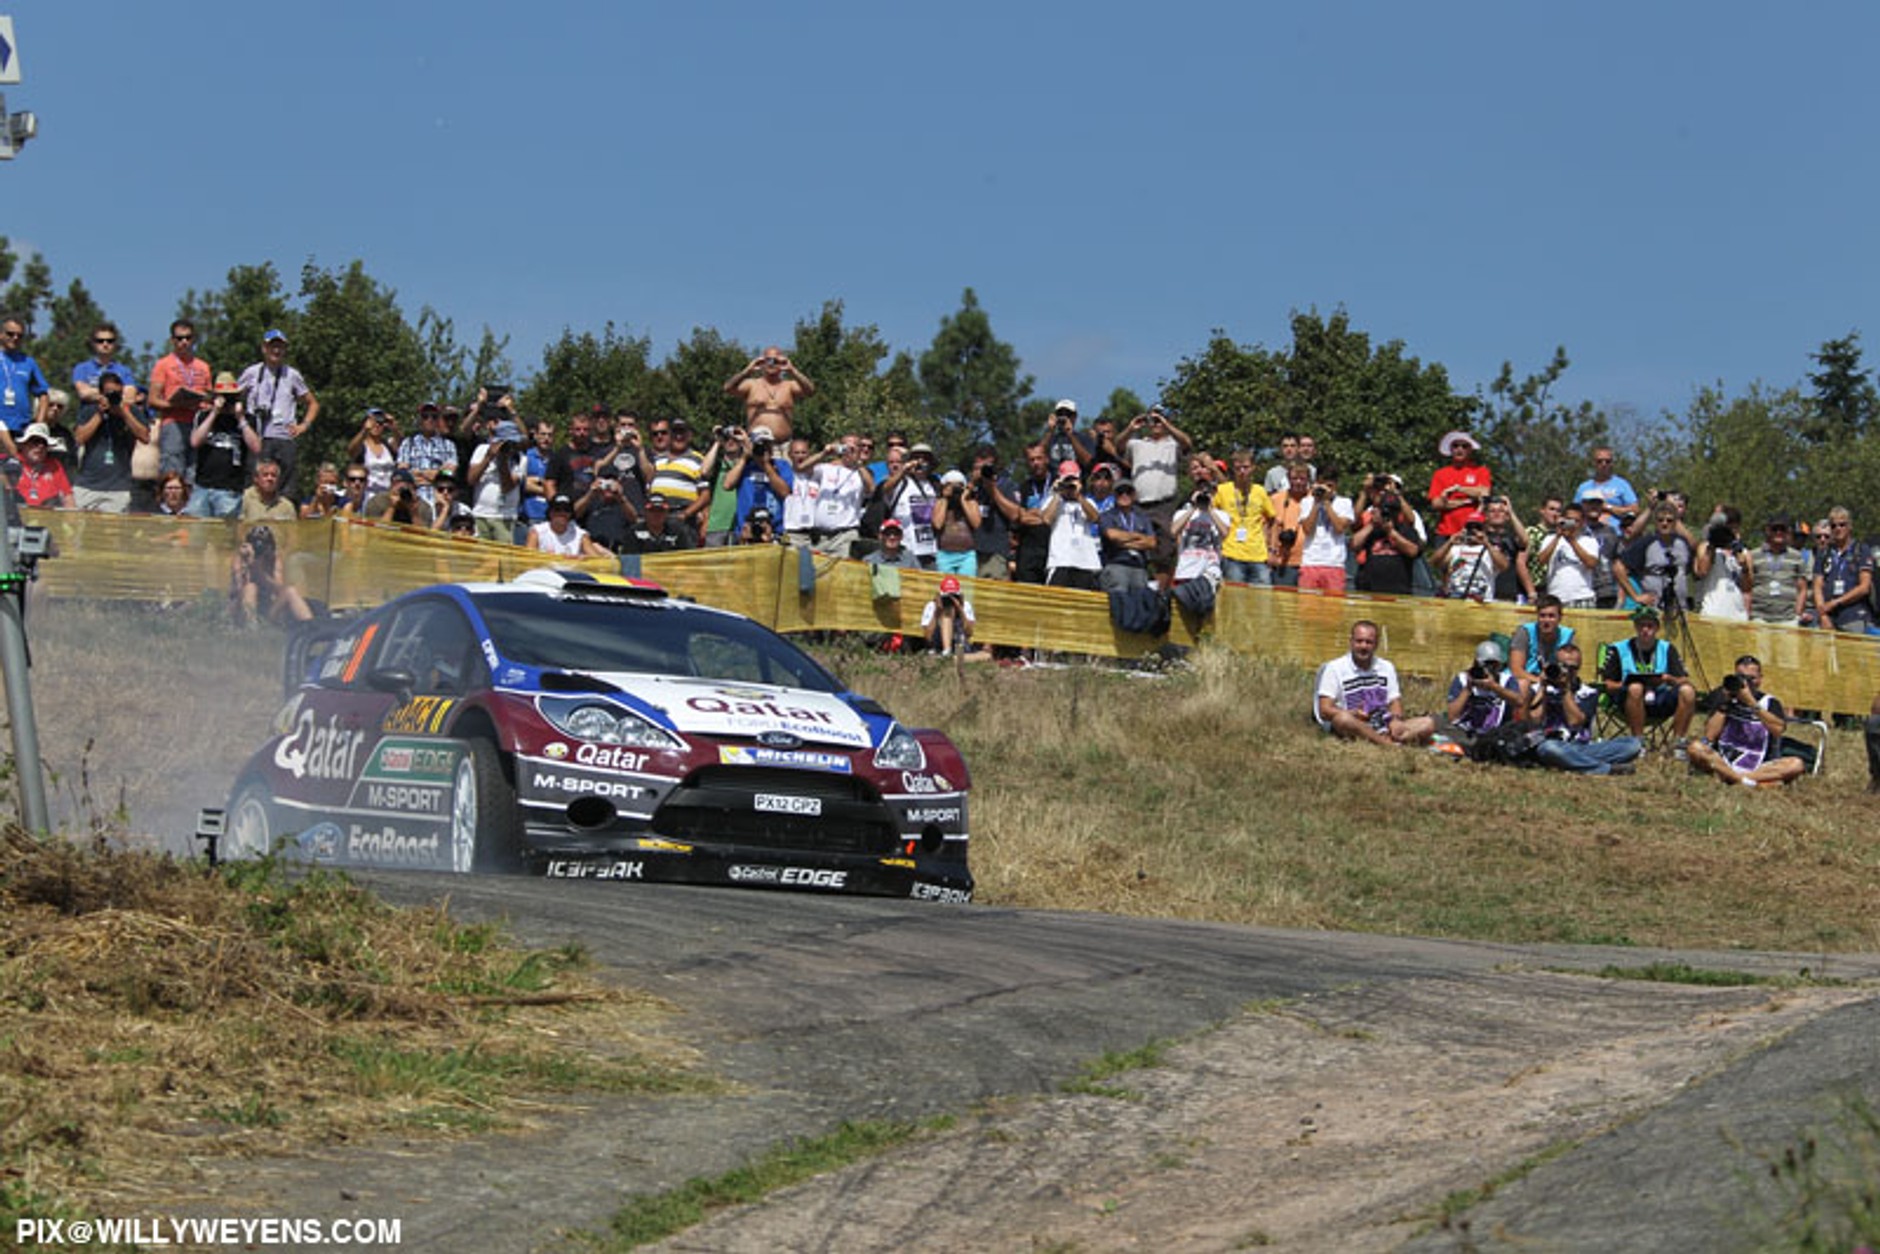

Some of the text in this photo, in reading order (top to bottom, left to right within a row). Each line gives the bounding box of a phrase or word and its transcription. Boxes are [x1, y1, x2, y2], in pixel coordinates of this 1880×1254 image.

[685, 696, 833, 724] Qatar
[274, 708, 364, 779] Qatar
[575, 743, 649, 771] Qatar
[756, 750, 847, 767] MICHELIN
[368, 785, 443, 811] M-SPORT
[533, 773, 645, 799] M-SPORT
[906, 808, 960, 823] M-SPORT
[348, 824, 439, 863] EcoBoost
[780, 867, 848, 887] EDGE
